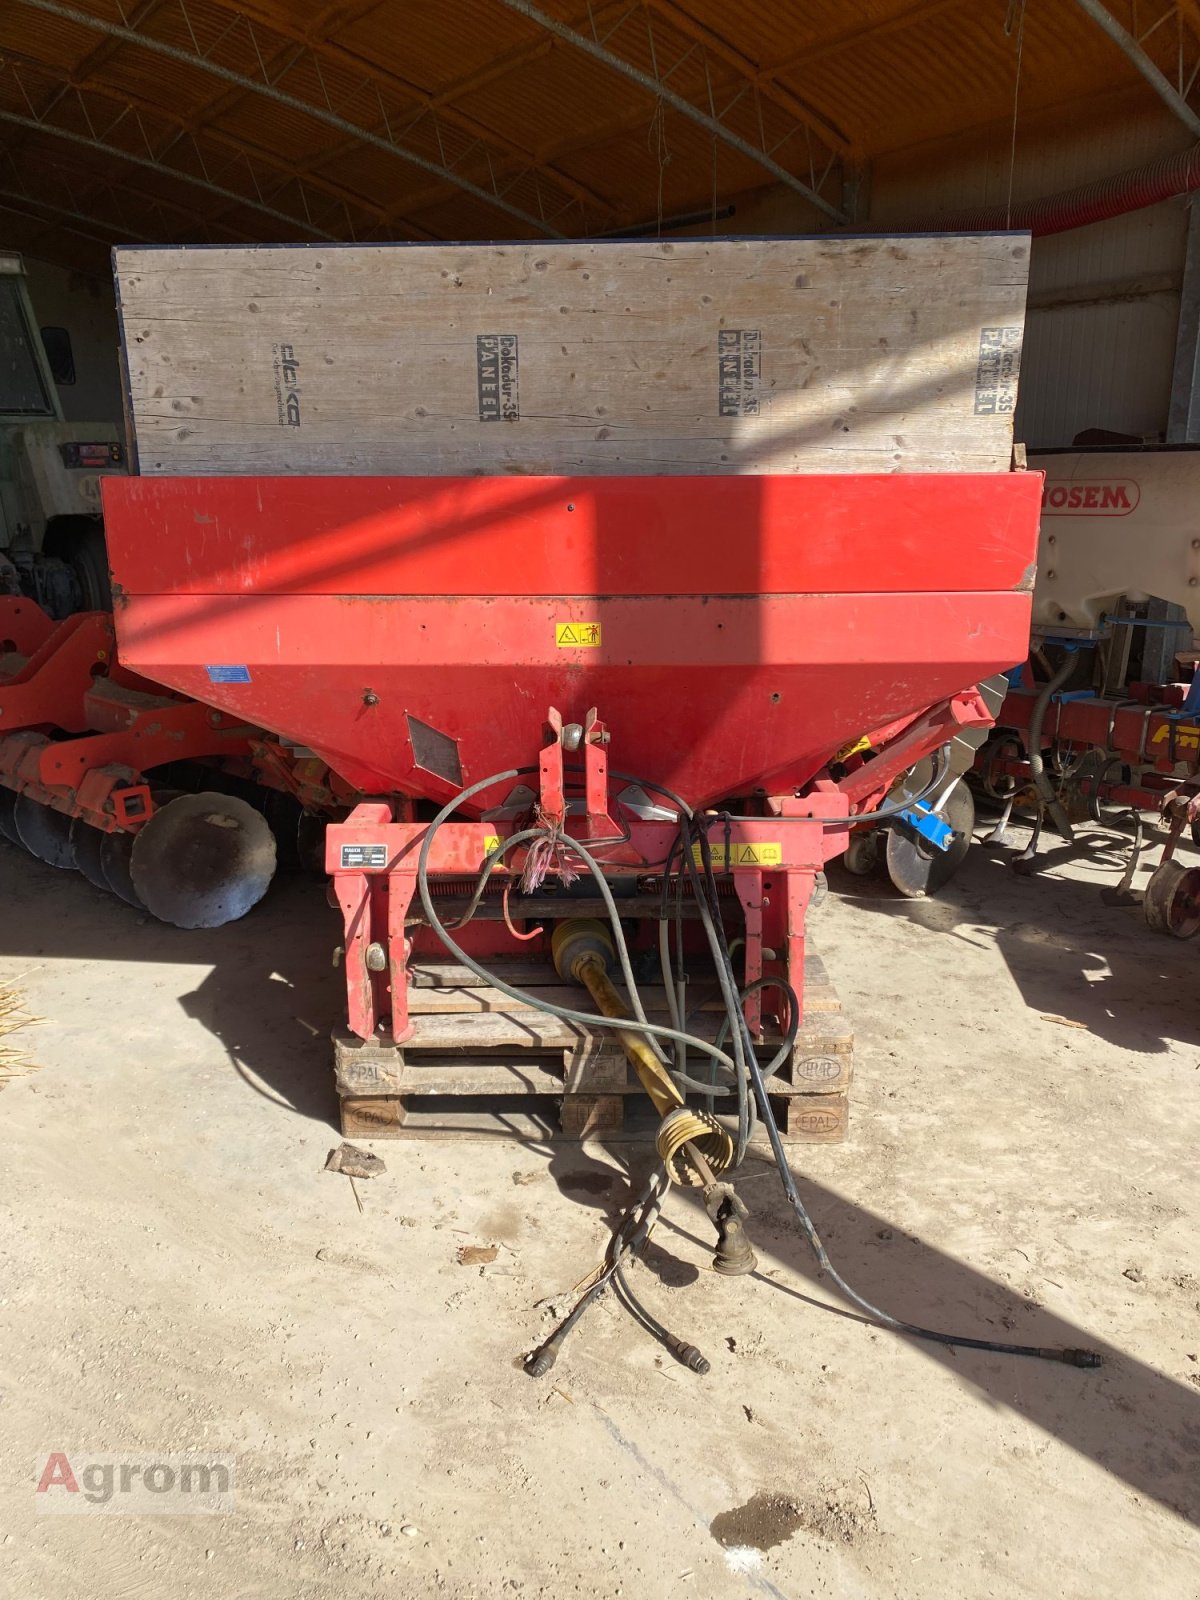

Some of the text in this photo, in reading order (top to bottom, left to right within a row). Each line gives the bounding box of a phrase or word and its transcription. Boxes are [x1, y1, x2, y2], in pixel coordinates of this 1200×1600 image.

[481, 338, 498, 419] PANEEL
[500, 337, 517, 419] Dokadur-3S
[801, 1116, 833, 1128] EPAL
